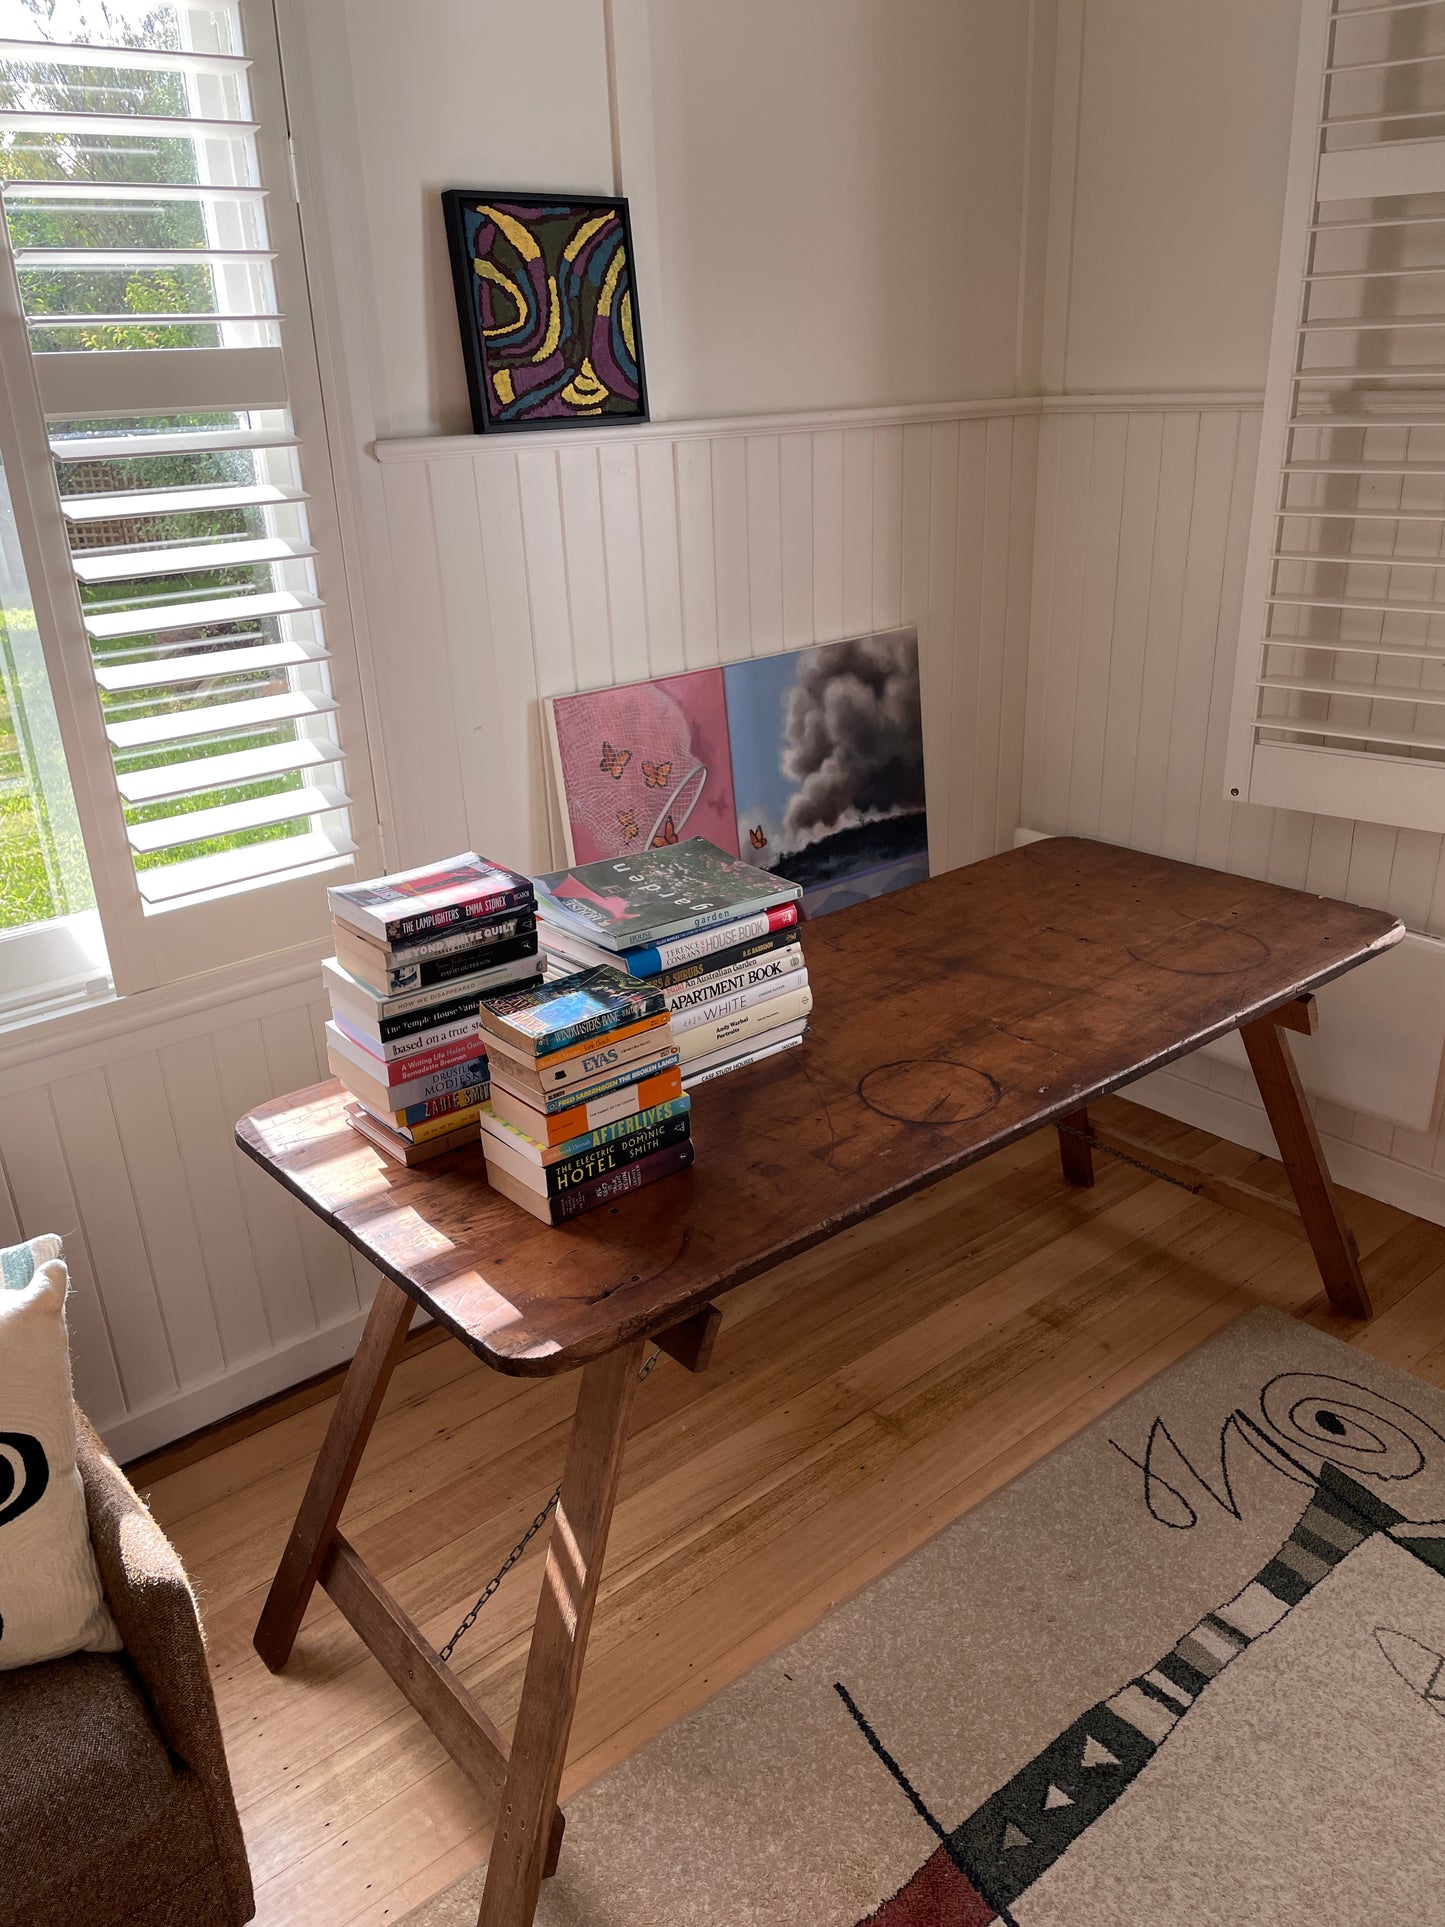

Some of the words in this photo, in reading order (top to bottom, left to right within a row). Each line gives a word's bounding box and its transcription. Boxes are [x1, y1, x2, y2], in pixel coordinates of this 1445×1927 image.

[612, 862, 714, 912] garden
[402, 921, 415, 934] THE
[414, 908, 460, 931] LAMPLIGHTERS
[465, 903, 483, 917] EMMA
[694, 909, 730, 928] garden
[394, 940, 444, 962] BEYOND
[443, 930, 483, 952] WHITE
[665, 941, 700, 958] TERENCE
[706, 924, 737, 951] HOUSE
[738, 918, 764, 940] BOOK
[440, 965, 460, 977] DAVID
[664, 972, 671, 985] &
[671, 963, 704, 985] SHRUBS
[685, 980, 696, 989] An
[696, 967, 733, 985] Australian
[733, 958, 757, 972] Garden
[397, 1001, 415, 1009] HOW
[416, 997, 429, 1005] WE
[430, 983, 476, 1001] DISAPPEARED
[670, 976, 745, 1012] APARTMENT
[749, 961, 783, 984] BOOK
[385, 1023, 401, 1036] The
[401, 1015, 431, 1030] Temple
[433, 1006, 457, 1021] House
[601, 1010, 620, 1025] BANE
[703, 995, 747, 1020] WHITE
[392, 1039, 423, 1056] based
[426, 1034, 440, 1046] on
[441, 1031, 447, 1041] a
[449, 1023, 469, 1038] true
[715, 1024, 730, 1034] Andy
[730, 1016, 749, 1028] Warhol
[716, 1028, 740, 1040] Portraits
[401, 1064, 407, 1072] A
[408, 1056, 432, 1070] Writing
[433, 1051, 445, 1061] Life
[446, 1046, 466, 1058] Helen
[402, 1063, 439, 1080] Bernadette
[440, 1053, 467, 1067] Brennan
[582, 1049, 619, 1073] EYAS
[701, 1072, 715, 1082] CASE
[715, 1065, 733, 1078] STUDY
[733, 1056, 755, 1071] HOUSES
[781, 1040, 799, 1050] TASCHEN
[558, 1096, 575, 1107] FRED
[575, 1079, 618, 1101] SABERHAGEN
[618, 1075, 632, 1084] THE
[631, 1065, 657, 1079] BROKEN
[657, 1056, 678, 1068] LANDS
[425, 1093, 461, 1118] ZADIE
[464, 1082, 490, 1106] SMIT
[592, 1101, 673, 1148] AFTERLIVES
[556, 1163, 573, 1175] THE
[575, 1146, 615, 1167] ELECTRIC
[622, 1125, 667, 1150] DOMINIC
[557, 1155, 616, 1190] HOTEL
[629, 1138, 660, 1158] SMITH
